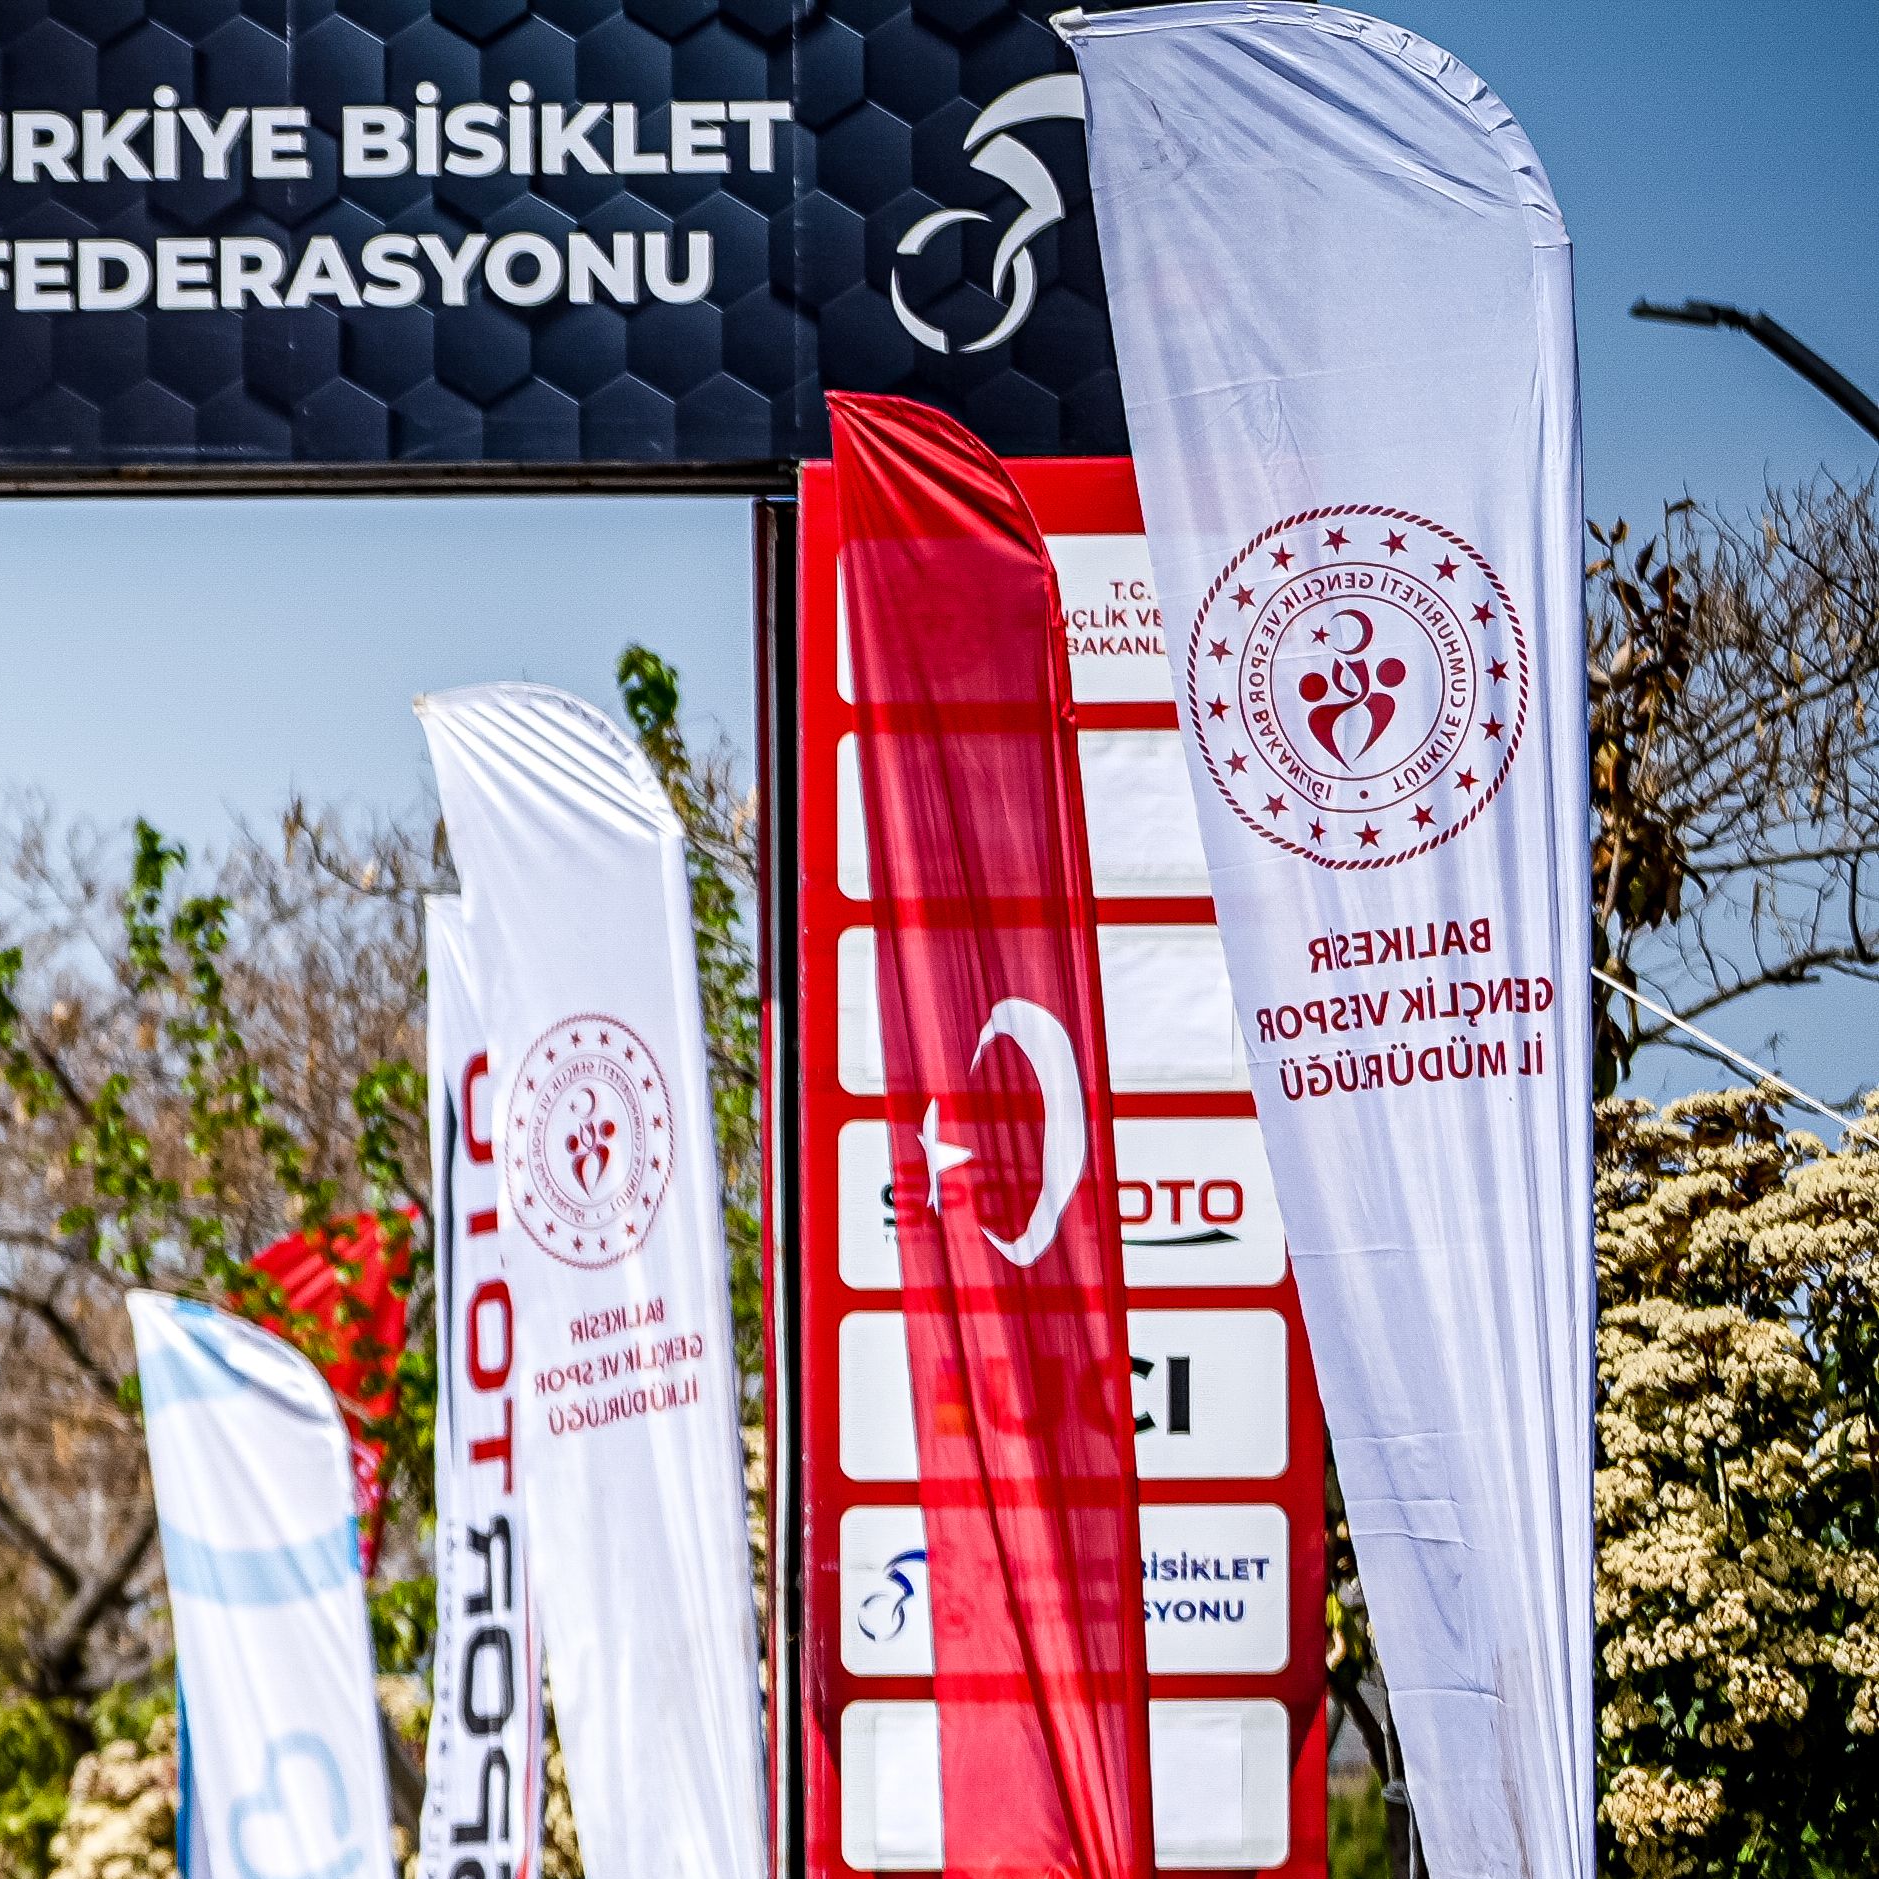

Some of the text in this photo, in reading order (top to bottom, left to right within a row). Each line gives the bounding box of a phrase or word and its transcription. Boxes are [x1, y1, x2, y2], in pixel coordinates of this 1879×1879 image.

[343, 80, 795, 180] BİSİKLET
[1109, 581, 1151, 600] T.C.
[1064, 604, 1128, 633] ÇLİK
[1066, 636, 1166, 656] BAKANL
